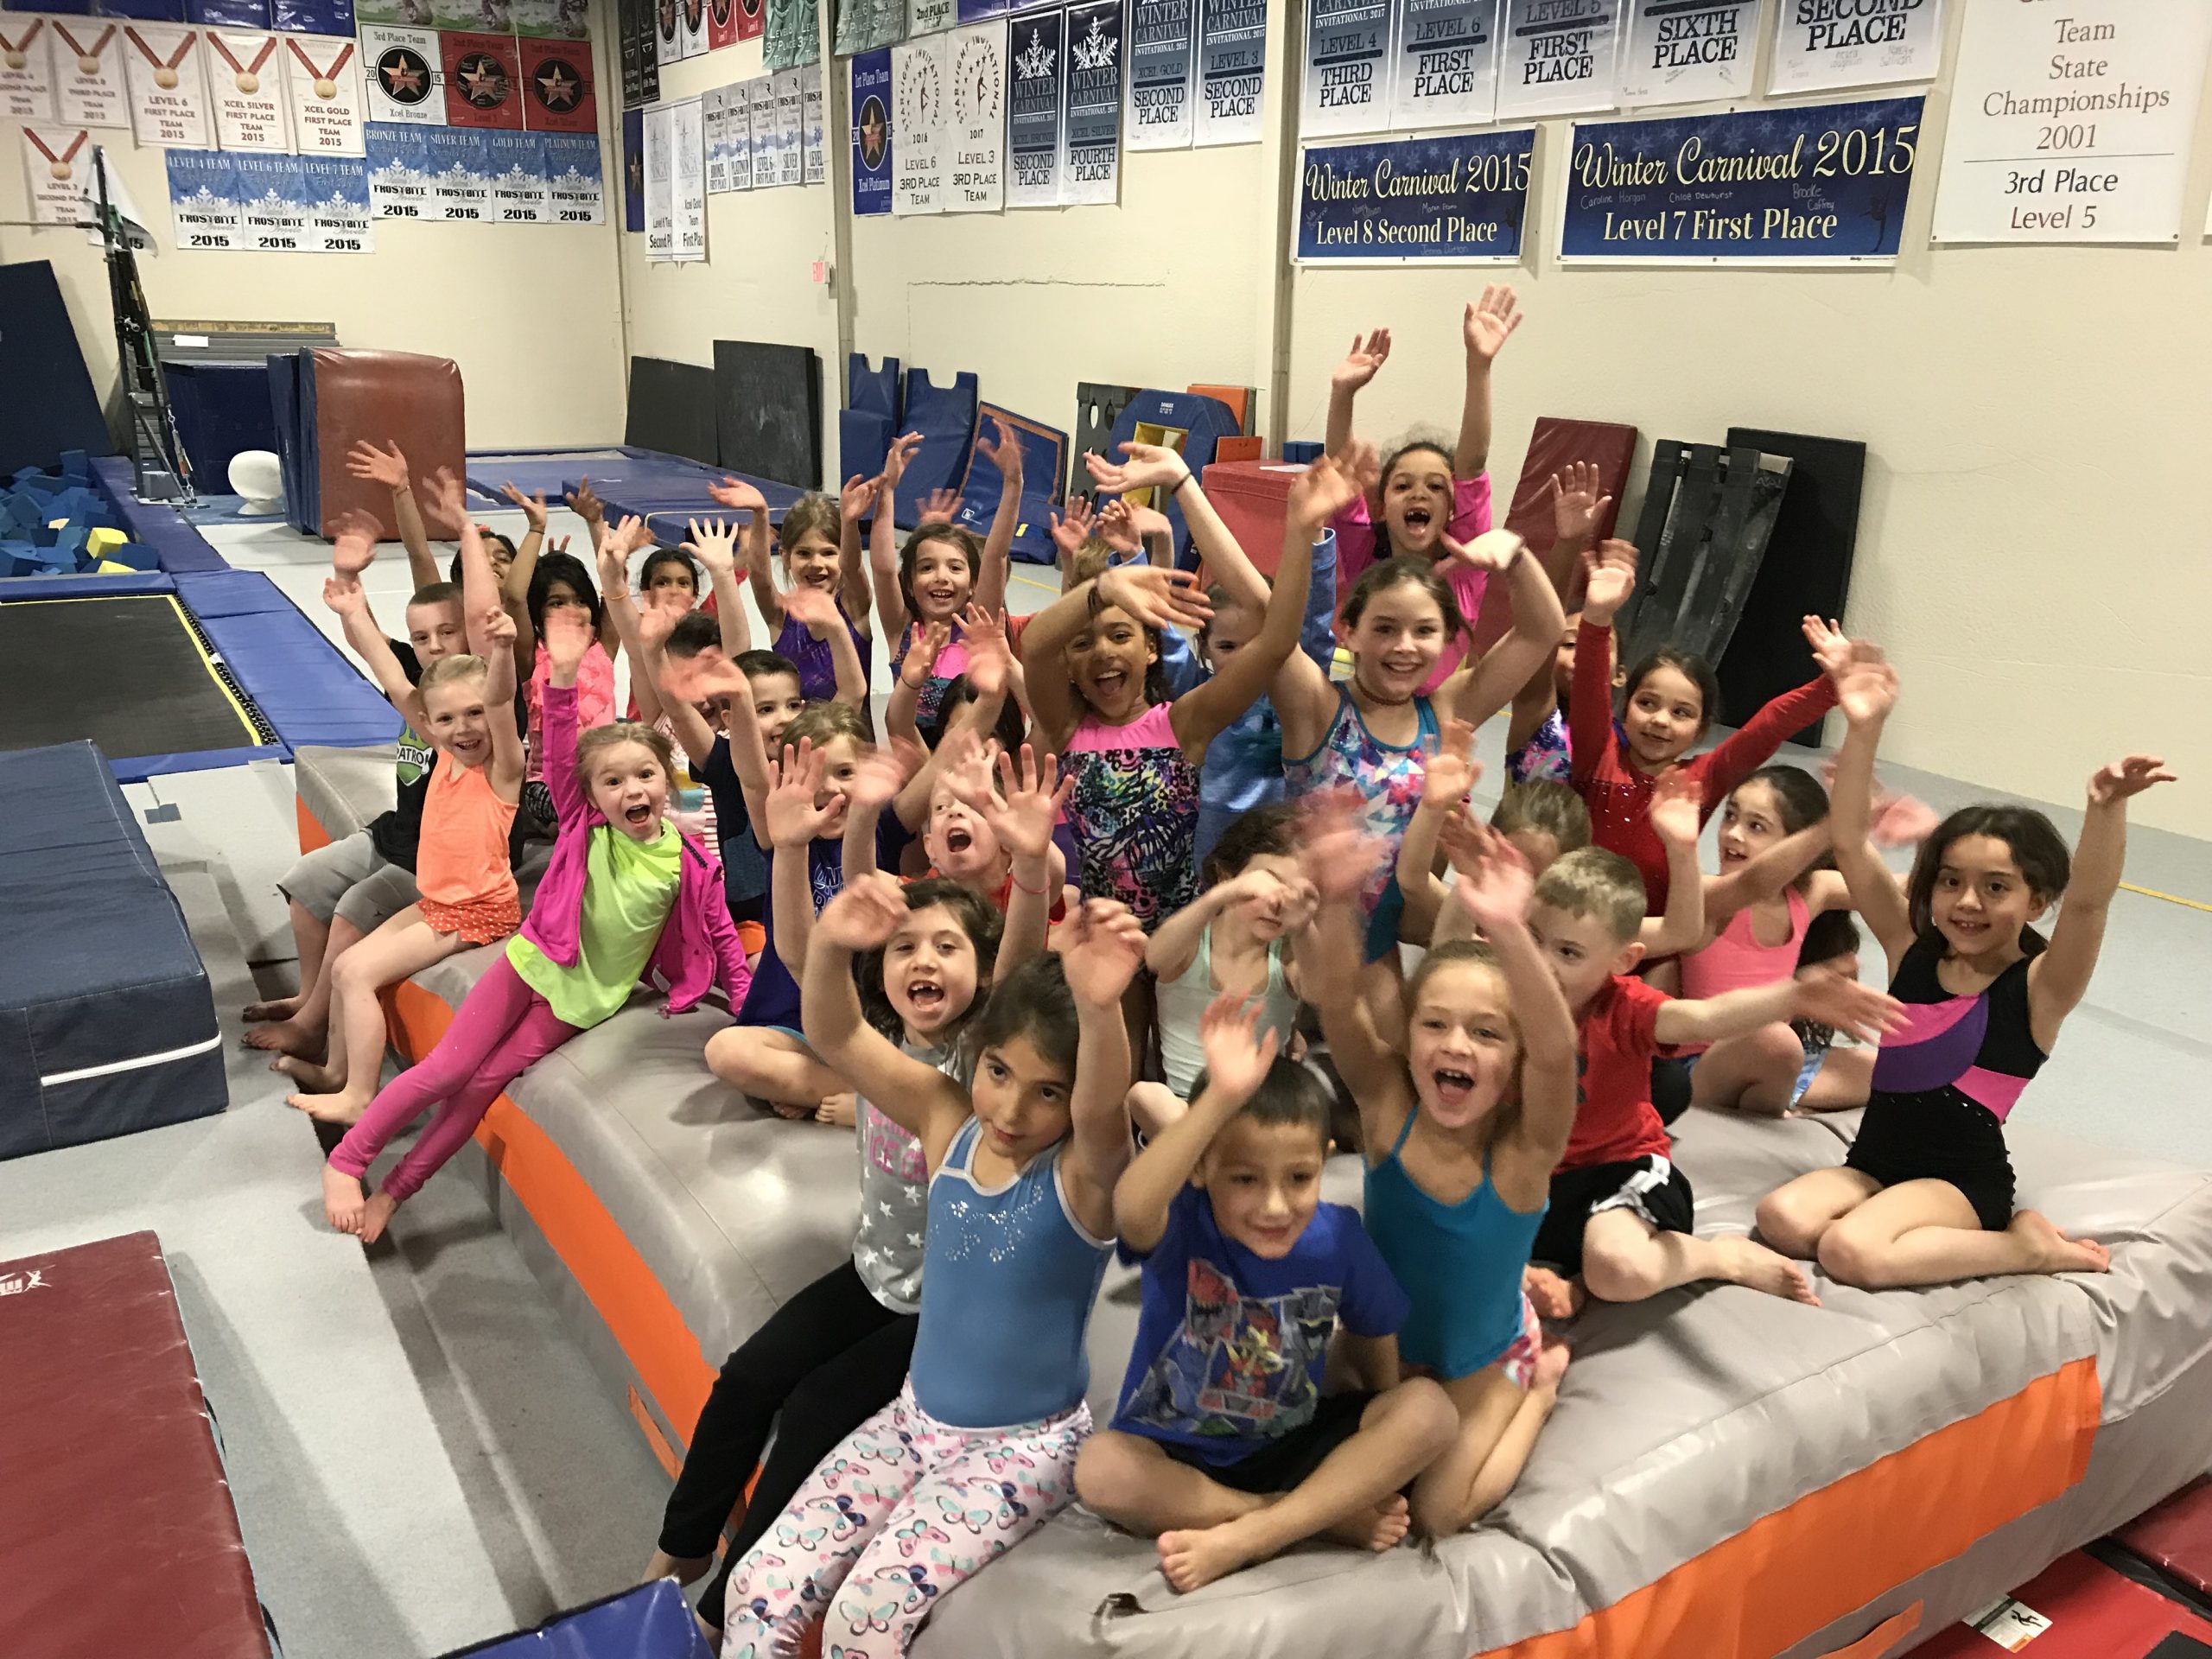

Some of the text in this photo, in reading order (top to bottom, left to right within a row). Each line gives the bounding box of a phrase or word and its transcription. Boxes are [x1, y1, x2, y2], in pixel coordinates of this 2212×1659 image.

[916, 2, 950, 19] 2nd PLACE
[1136, 1, 1189, 27] WINTER
[1315, 9, 1386, 29] INVITATIONAL 2017
[1525, 0, 1601, 23] LEVEL 5
[1206, 7, 1266, 33] CARNIVAL
[1415, 16, 1481, 41] LEVEL 6
[1657, 9, 1740, 43] SIXTH
[373, 31, 426, 45] 3rd Place Team
[1135, 21, 1188, 44] CARNIVAL
[1206, 31, 1252, 46] INVITATIONAL
[1805, 13, 1908, 52] PLACE
[2054, 17, 2115, 43] Team
[1135, 44, 1175, 56] INVITATIONAL
[1320, 33, 1377, 55] LEVEL 4
[1528, 31, 1593, 60] FIRST
[1652, 35, 1738, 69] PLACE
[1211, 50, 1259, 70] LEVEL 3
[1418, 49, 1474, 75] FIRST
[2049, 54, 2109, 80] State
[366, 69, 442, 82] 20 15
[862, 71, 875, 86] Place
[876, 69, 889, 84] Team
[1137, 62, 1183, 79] XCEL GOLD
[1320, 62, 1373, 86] THIRD
[1522, 54, 1594, 85] PLACE
[1071, 66, 1118, 91] WINTER
[1414, 73, 1474, 98] PLACE
[1014, 76, 1056, 99] WINTER
[1071, 86, 1118, 105] CARNIVAL
[1205, 76, 1262, 100] SECOND
[1319, 83, 1372, 107] PLACE
[149, 96, 188, 107] LEVEL 6
[224, 100, 275, 111] XCEL SILVER
[1014, 96, 1056, 113] CARNIVAL
[1134, 86, 1185, 108] SECOND
[1984, 82, 2171, 118] Championships
[143, 107, 195, 118] FIRST PLACE
[304, 105, 350, 116] XCEL GOLD
[390, 109, 428, 119] Xcel Bronze
[1070, 106, 1107, 118] INVITATIONAL
[1139, 105, 1179, 124] PLACE
[1211, 97, 1255, 118] PLACE
[159, 119, 183, 128] TEAM
[250, 112, 276, 121] PLACE
[328, 118, 353, 126] PLACE
[160, 130, 185, 139] 2015
[240, 123, 263, 131] TEAM
[318, 128, 340, 137] TEAM
[241, 133, 264, 142] 2015
[319, 137, 342, 147] 2015
[366, 130, 422, 143] BRONZE TEAM
[430, 135, 480, 147] SILVER TEAM
[493, 137, 536, 149] GOLD TEAM
[544, 137, 596, 150] PLATINUM TEAM
[2036, 124, 2098, 150] 2001
[905, 156, 937, 171] LEVEL 6
[957, 150, 995, 164] LEVEL 3
[1014, 153, 1054, 170] SECOND
[1070, 147, 1116, 166] FOURTH
[1574, 124, 1918, 188] Winter Carnival 2015
[238, 161, 298, 174] LEVEL 6 TEAM
[306, 162, 364, 176] LEVEL 7 TEAM
[1075, 164, 1111, 181] PLACE
[899, 176, 940, 190] 3RD PLACE
[952, 173, 997, 185] 3RD PLACE
[1018, 169, 1050, 186] PLACE
[1306, 152, 1533, 202] Winter Carnival 2015
[2004, 168, 2119, 194] 3rd Place
[911, 194, 930, 205] TEAM
[964, 190, 987, 201] TEAM
[1580, 193, 1613, 210] Caroline
[1695, 190, 1734, 201] Dewhurst
[383, 205, 418, 217] 2015
[445, 207, 480, 219] 2015
[503, 209, 537, 220] 2015
[559, 211, 592, 222] 2015
[2010, 204, 2097, 230] Level 5
[1317, 216, 1497, 245] Level 8 Second Place
[1603, 207, 1838, 242] Level 7 First Place
[190, 235, 230, 247] 2015
[258, 237, 297, 249] 2015
[325, 238, 361, 251] 2015
[650, 234, 667, 249] Second
[683, 232, 693, 247] First
